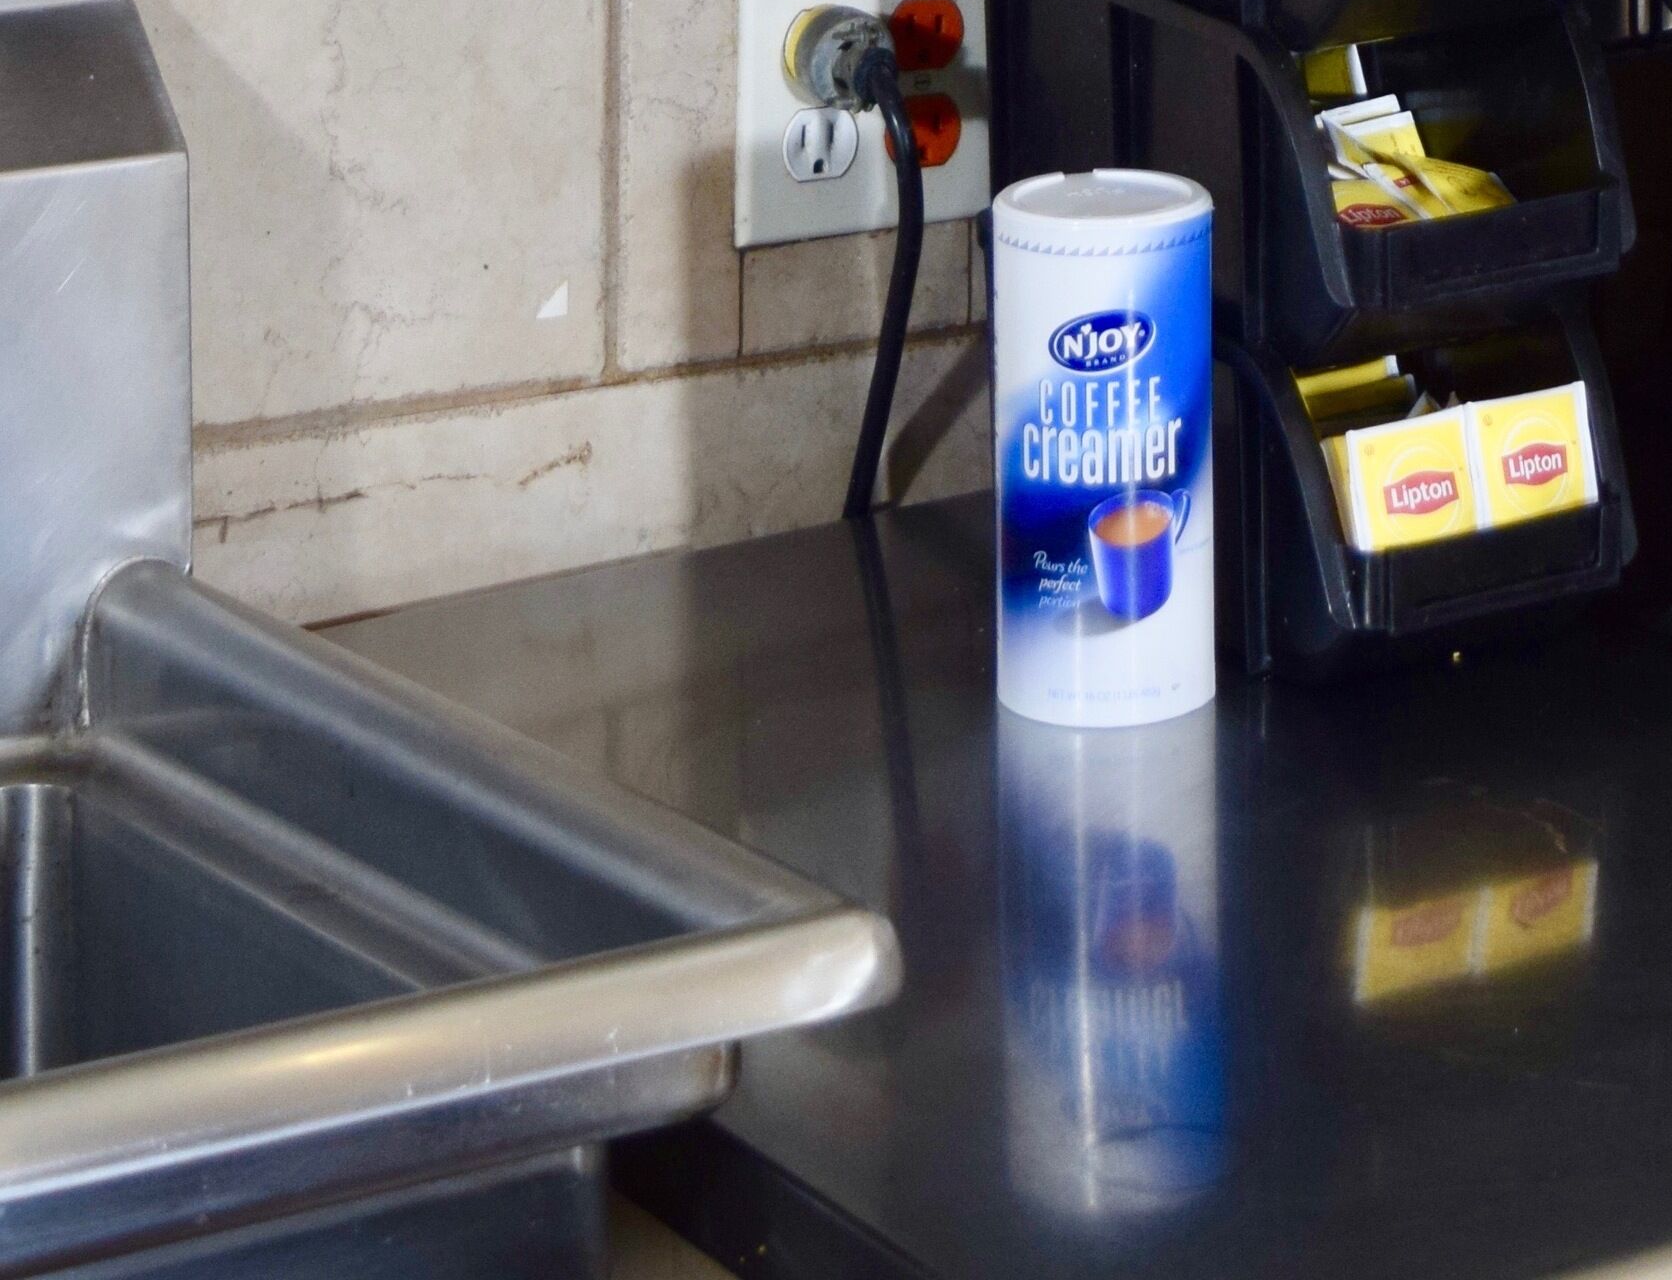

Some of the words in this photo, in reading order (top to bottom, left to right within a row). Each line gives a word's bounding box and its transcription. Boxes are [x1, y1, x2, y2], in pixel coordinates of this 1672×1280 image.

[1341, 205, 1399, 224] Lipton
[1085, 354, 1127, 368] BRAND
[1040, 376, 1161, 428] COFFEE
[1023, 417, 1182, 485] creamer
[1508, 451, 1562, 480] Lipton
[1391, 478, 1453, 510] Lipton
[1033, 550, 1065, 574] Pours
[1067, 558, 1088, 574] the
[1039, 575, 1081, 592] perfect
[1039, 595, 1081, 609] portion
